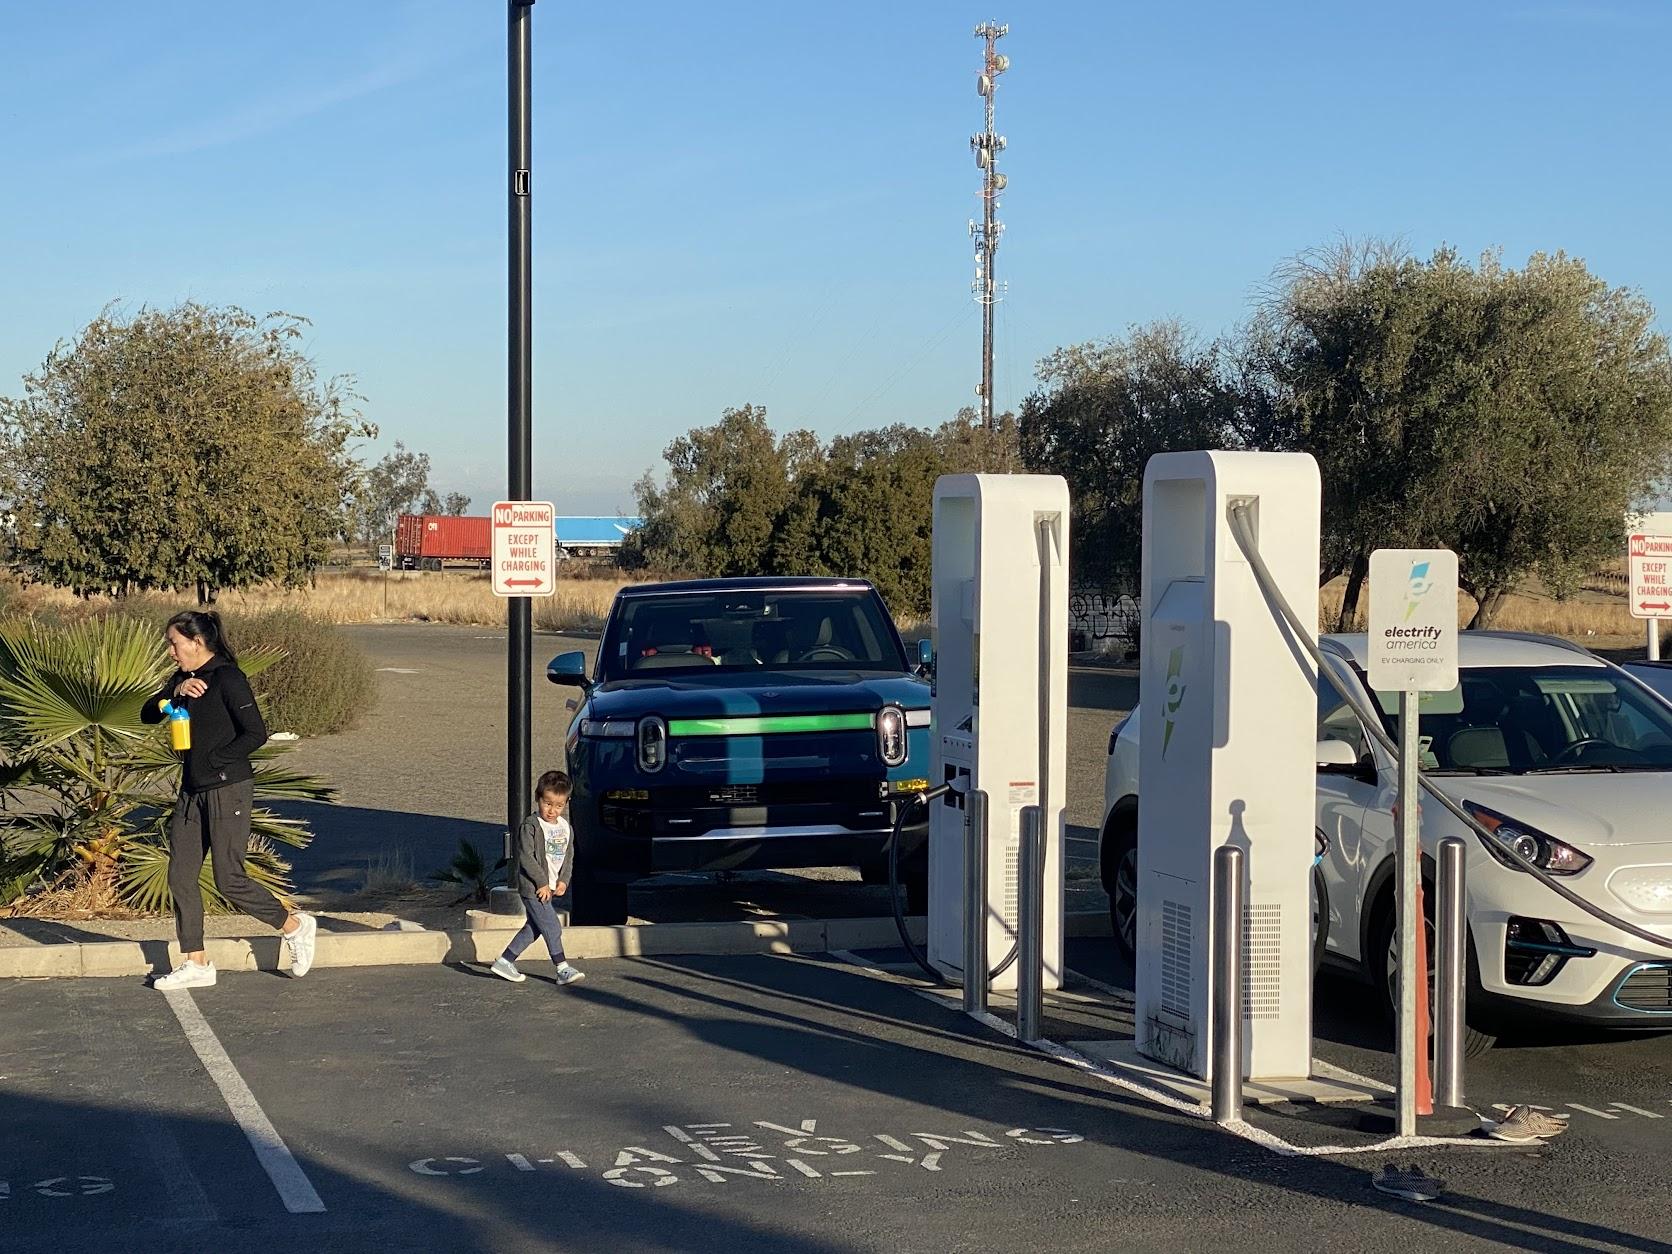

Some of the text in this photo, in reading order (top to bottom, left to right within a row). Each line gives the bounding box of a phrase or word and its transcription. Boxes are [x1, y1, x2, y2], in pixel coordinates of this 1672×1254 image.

[495, 508, 549, 524] NO PARKING
[508, 534, 539, 545] EXCEPT
[509, 547, 537, 558] WHILE
[1632, 539, 1672, 554] NO PARKIN
[501, 561, 546, 572] CHARGING
[1642, 563, 1667, 573] EXCEPT
[1644, 574, 1666, 585] WHILE
[1385, 626, 1442, 640] electrify
[1386, 638, 1437, 650] america
[408, 1127, 1084, 1176] CHARGING
[602, 1151, 943, 1188] ONLY
